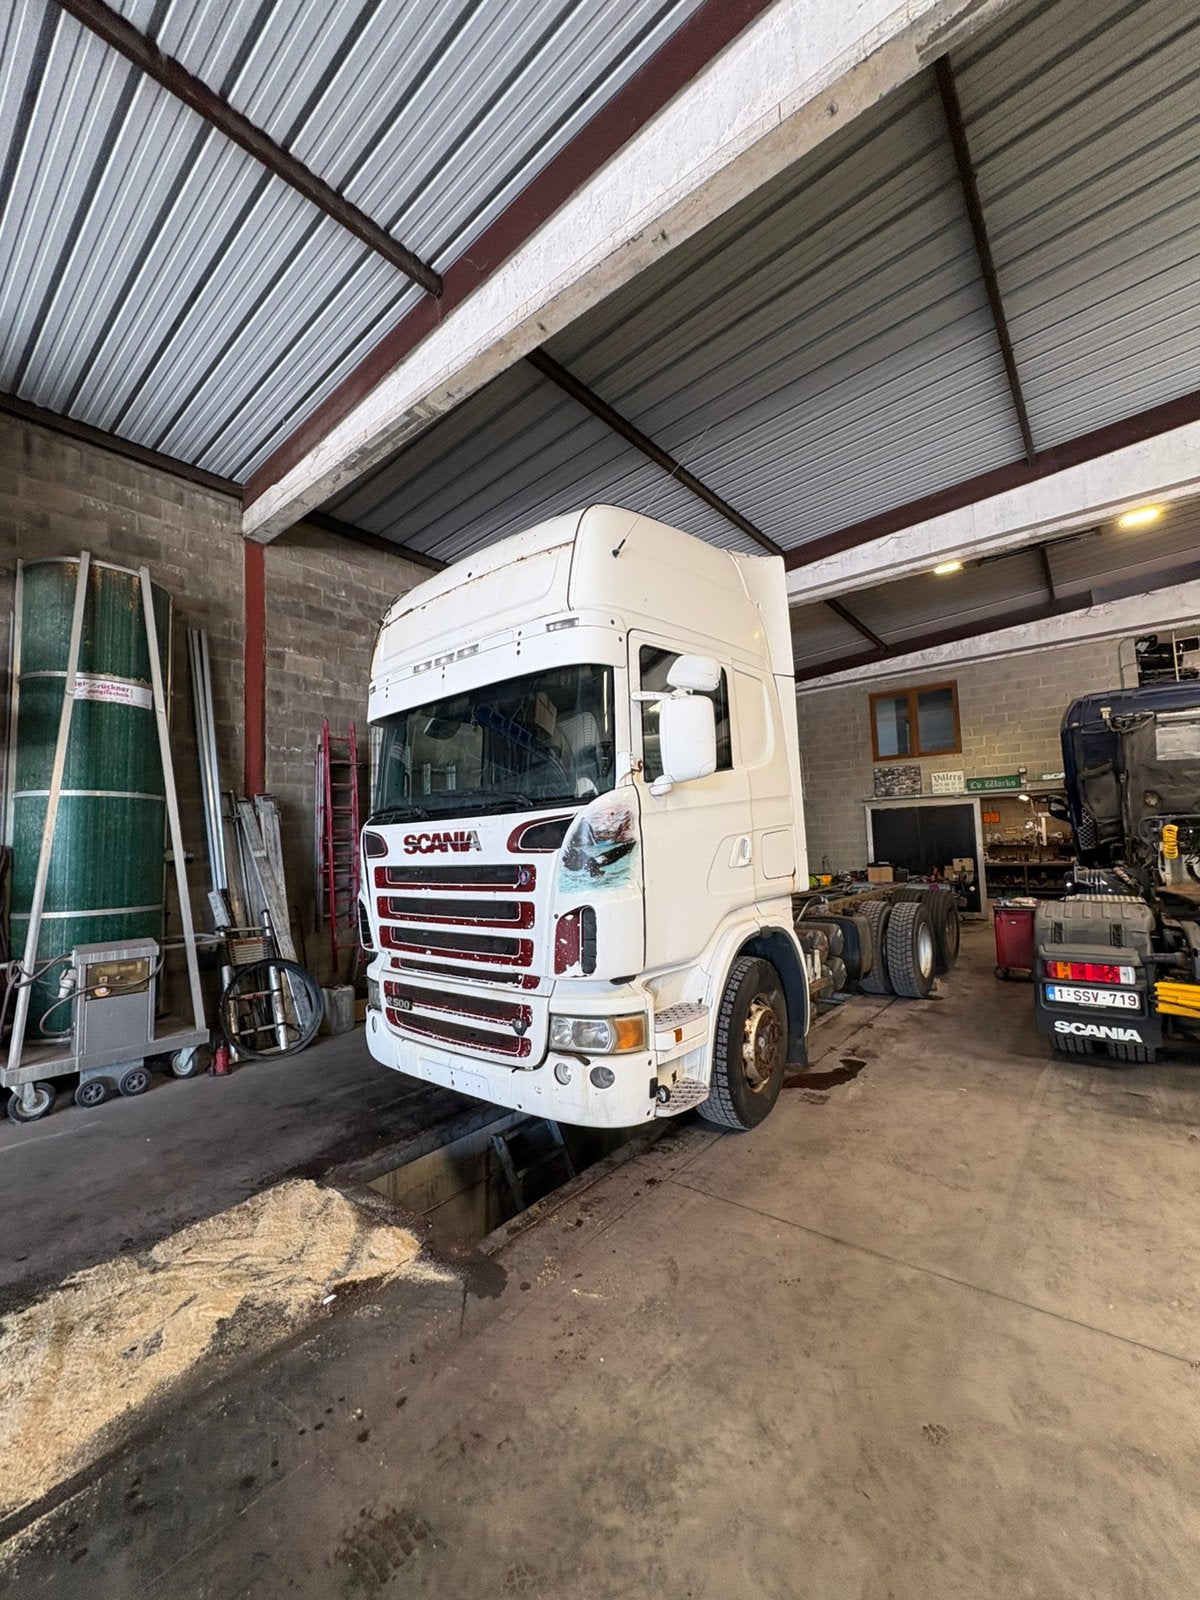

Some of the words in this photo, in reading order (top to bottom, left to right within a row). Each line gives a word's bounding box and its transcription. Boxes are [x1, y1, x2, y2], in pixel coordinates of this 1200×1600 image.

[932, 773, 962, 782] Villers
[984, 779, 1016, 788] Works
[403, 830, 482, 854] SCANIA
[393, 997, 410, 1009] 500
[1057, 988, 1137, 1007] 1-SSV-719
[1054, 1020, 1143, 1043] SCANIA
